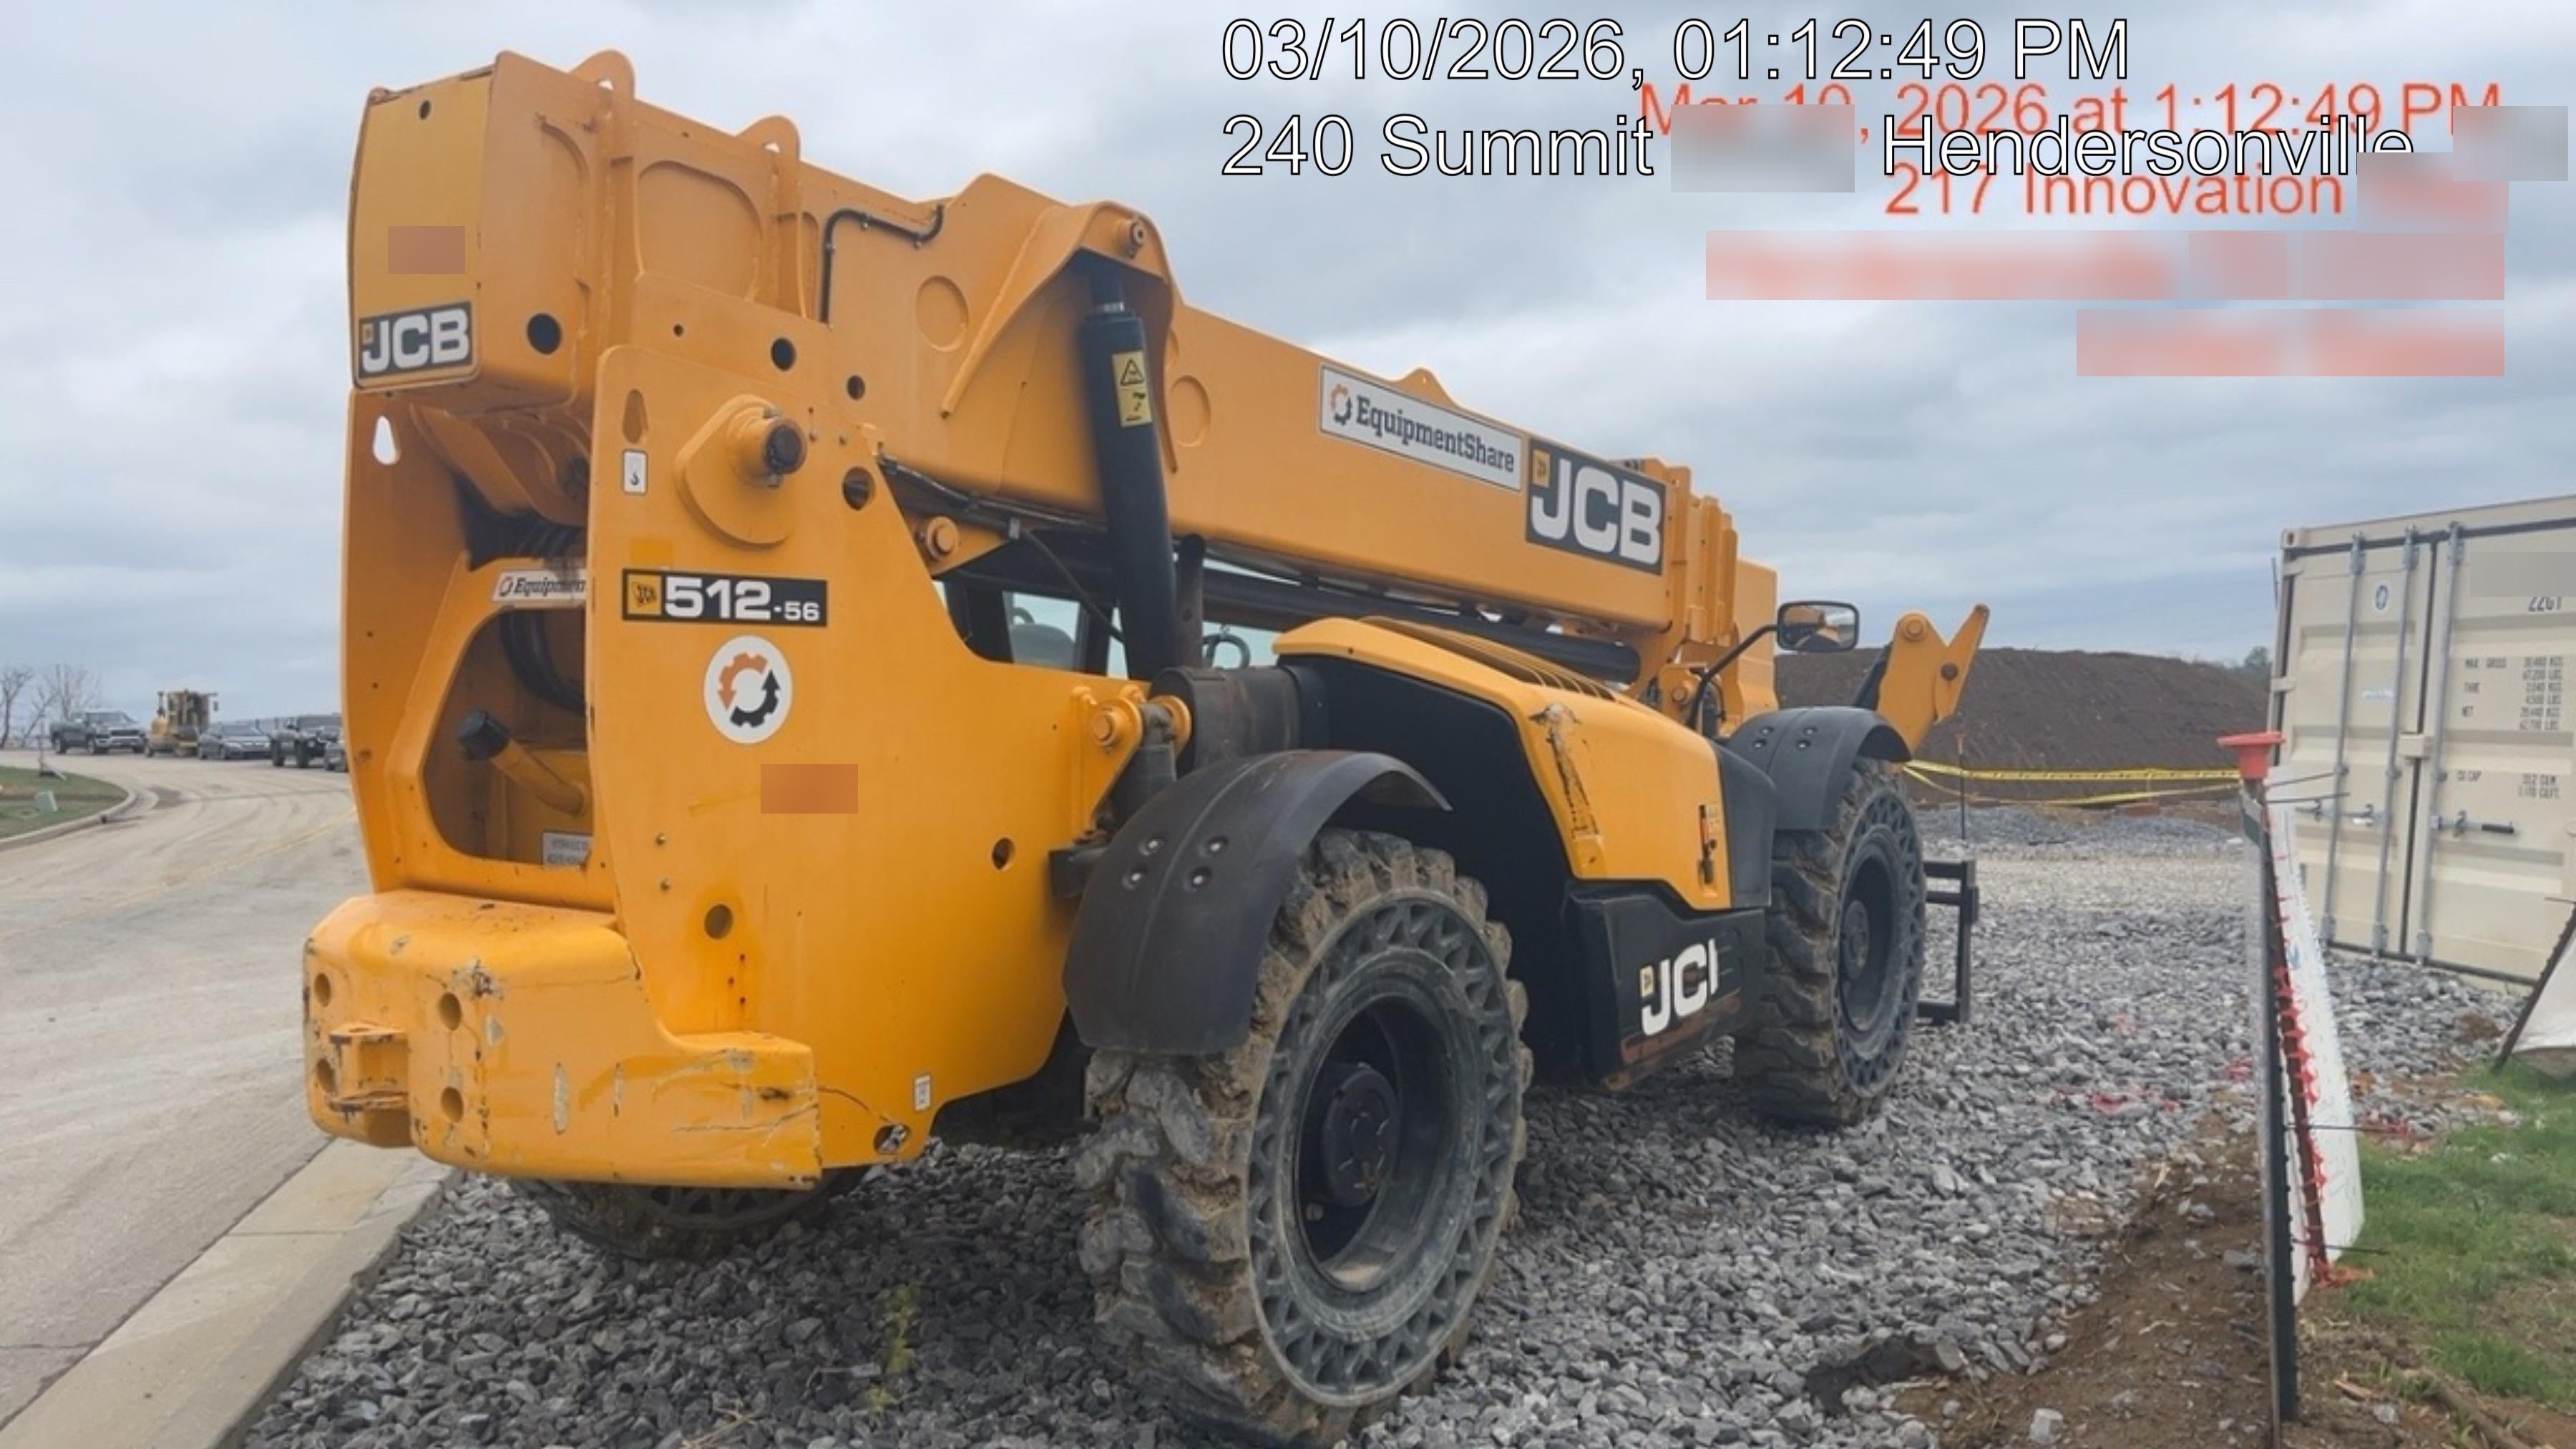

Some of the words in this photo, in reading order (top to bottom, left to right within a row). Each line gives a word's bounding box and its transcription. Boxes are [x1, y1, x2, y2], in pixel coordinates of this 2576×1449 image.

[362, 308, 469, 373] JCB
[1356, 395, 1514, 472] EquipmentShare
[1531, 458, 1662, 565] JCB
[665, 576, 820, 621] 512-56
